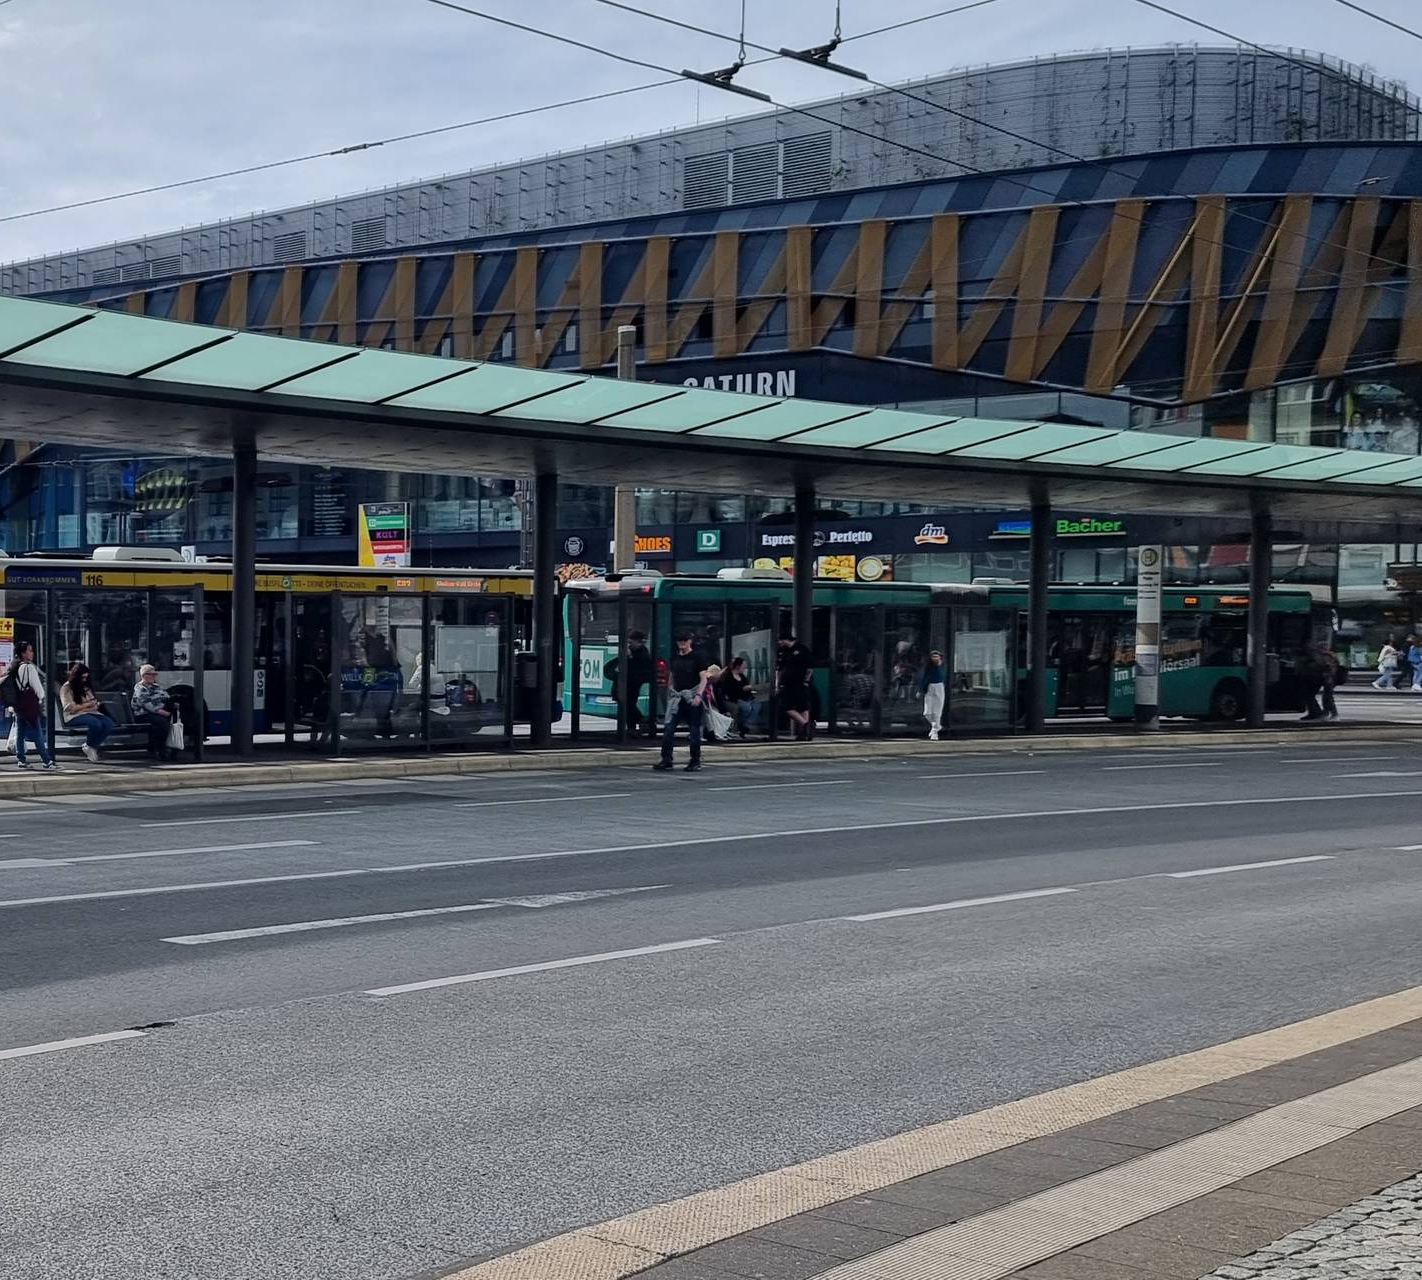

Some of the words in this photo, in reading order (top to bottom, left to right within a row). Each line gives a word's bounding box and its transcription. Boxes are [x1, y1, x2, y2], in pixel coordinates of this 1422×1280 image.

[920, 524, 945, 537] dm
[1057, 519, 1121, 532] Bacher
[702, 533, 715, 545] D
[762, 534, 796, 546] Espres
[86, 575, 103, 586] 116
[1114, 668, 1129, 681] im
